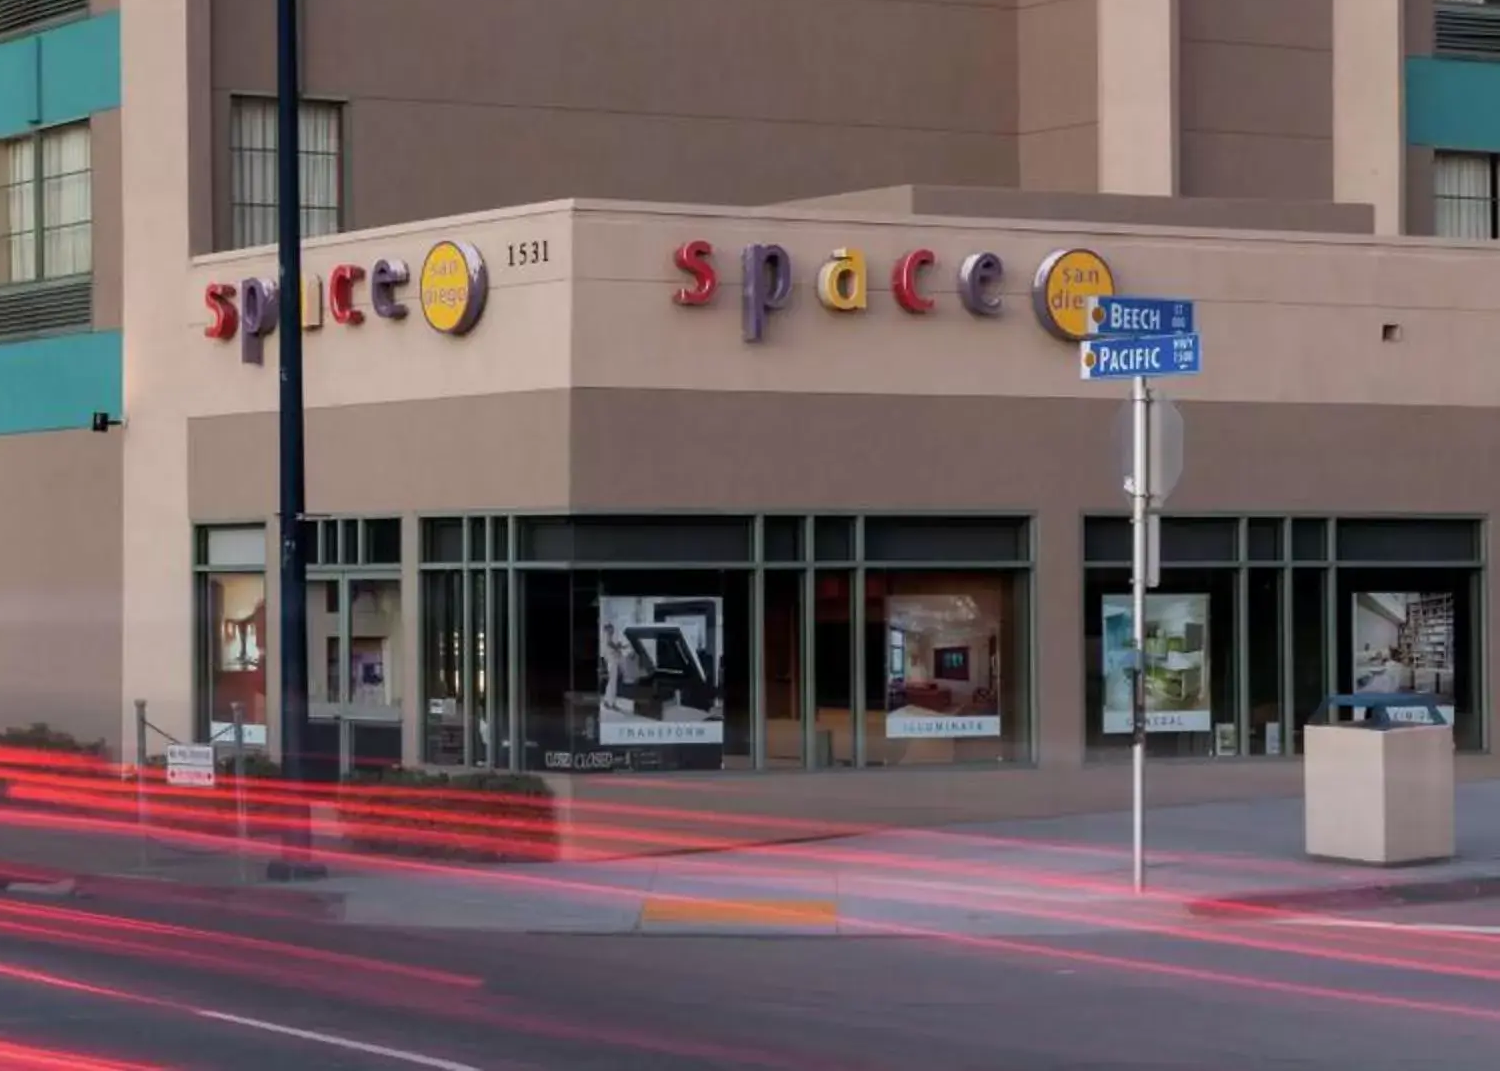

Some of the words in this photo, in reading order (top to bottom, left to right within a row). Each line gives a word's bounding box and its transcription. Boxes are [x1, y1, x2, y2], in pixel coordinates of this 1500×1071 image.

[508, 240, 549, 267] 1531
[432, 260, 459, 276] san
[1062, 268, 1099, 284] san
[424, 286, 467, 310] diego
[672, 239, 1004, 343] space
[1051, 289, 1085, 310] die
[205, 259, 410, 366] spce
[1110, 303, 1161, 329] BEECH
[1100, 347, 1161, 371] PACIFIC
